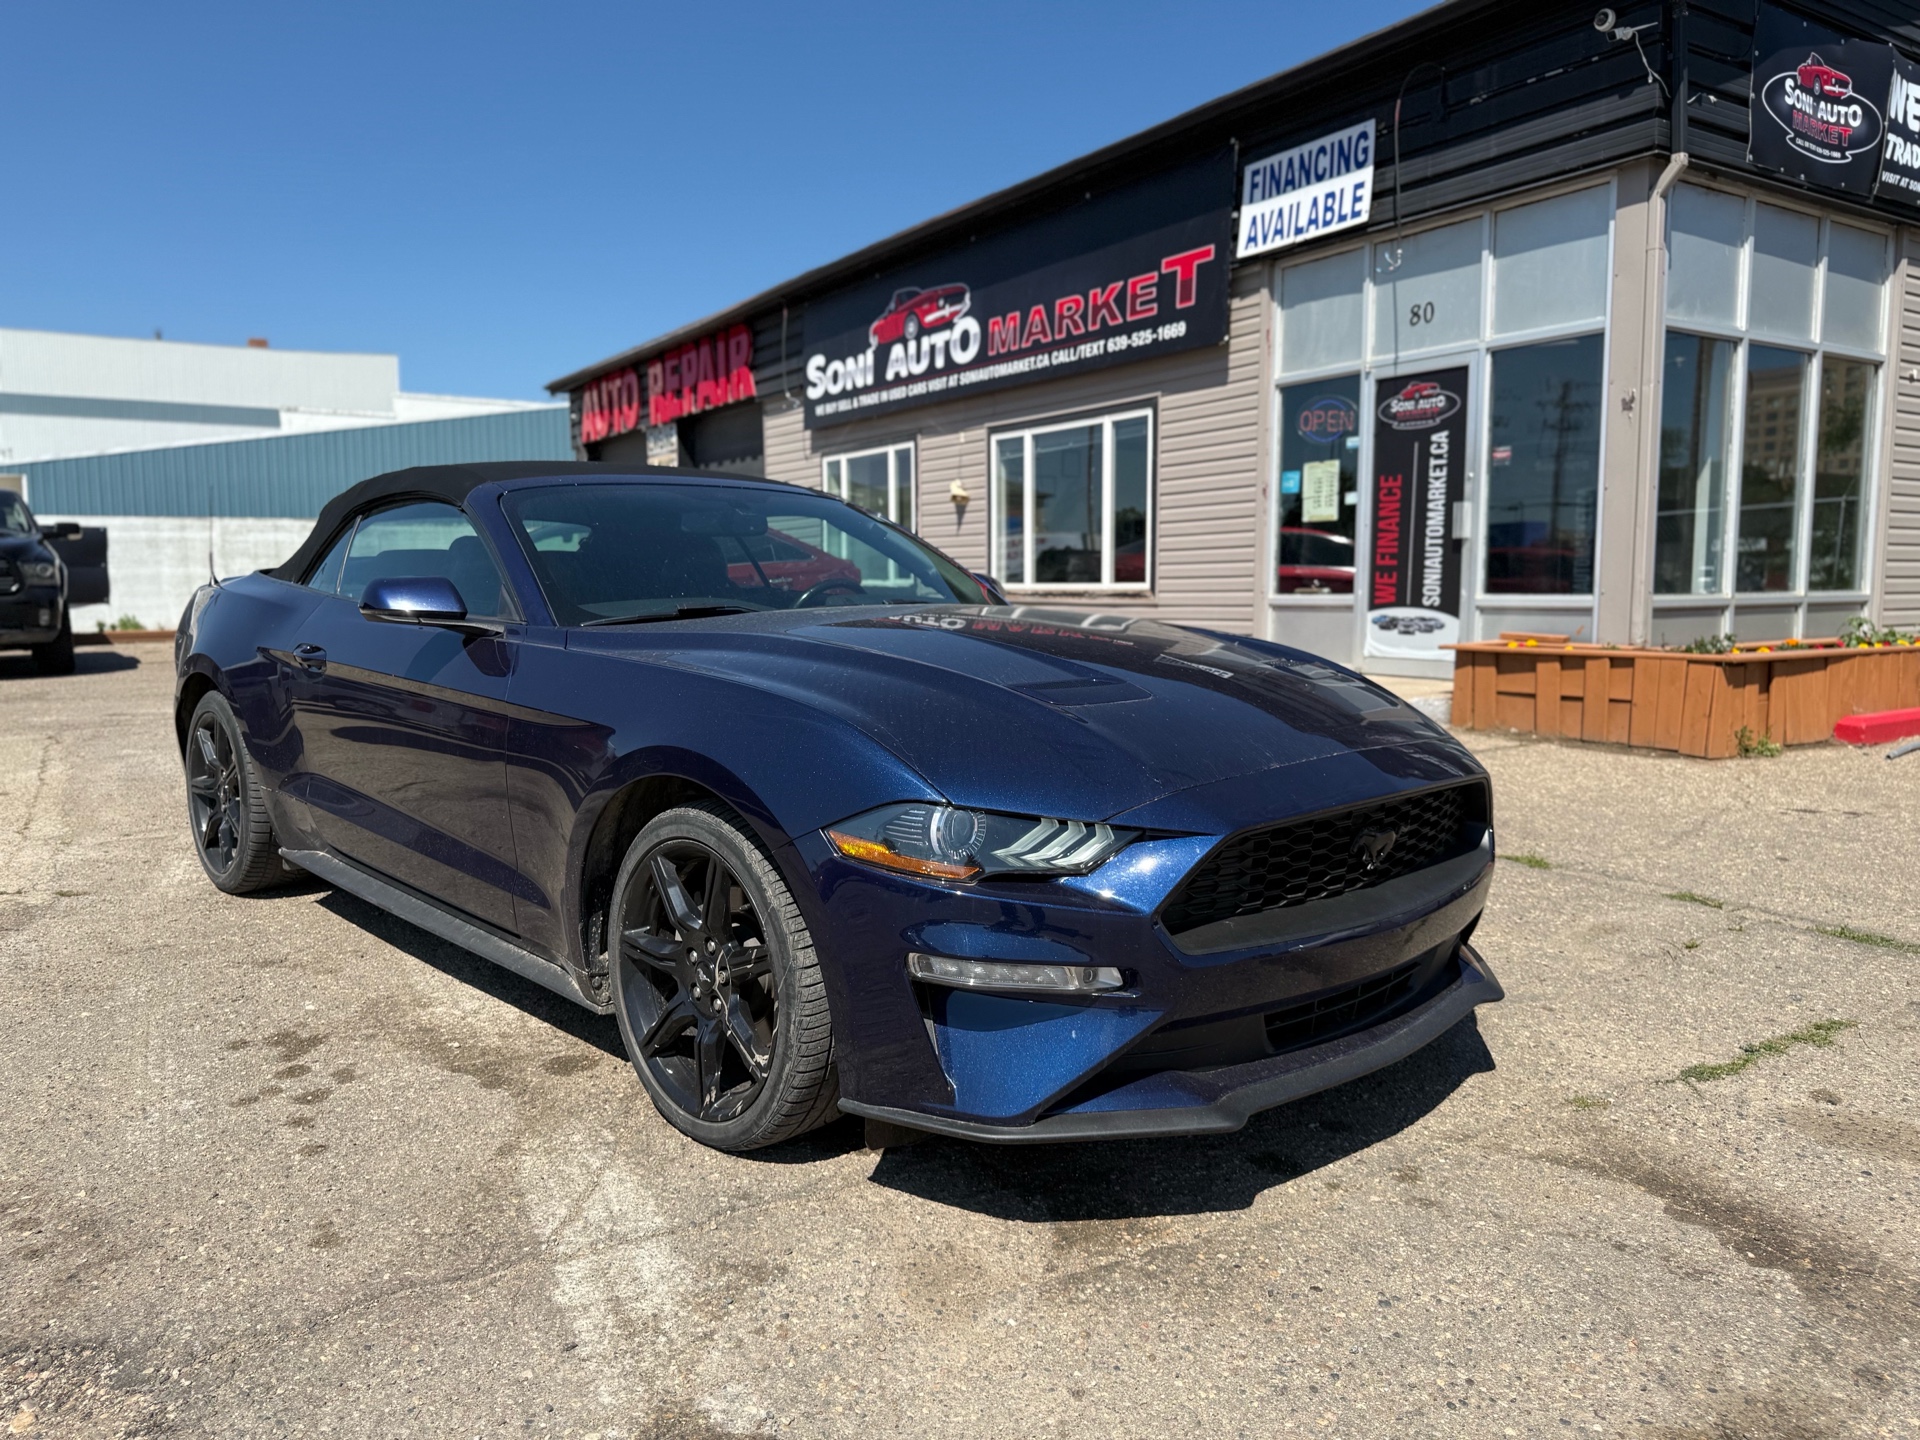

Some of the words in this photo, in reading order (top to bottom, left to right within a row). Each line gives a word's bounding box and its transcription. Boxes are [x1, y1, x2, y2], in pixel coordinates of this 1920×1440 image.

[1784, 77, 1813, 115] SONI
[1817, 100, 1862, 127] AUTO
[1792, 110, 1853, 147] MARKET
[1249, 130, 1370, 204] FINANCING
[1882, 170, 1900, 184] VISIT
[1901, 175, 1909, 187] AT
[1245, 180, 1366, 250] AVAILABLE
[806, 350, 874, 400] SONI
[885, 316, 982, 381] AUTO
[987, 244, 1215, 356] MARKET
[1408, 301, 1435, 326] 80
[581, 367, 641, 444] AUTO
[648, 324, 757, 426] REPAIR
[889, 387, 907, 401] USED
[908, 382, 927, 397] CARS
[928, 377, 947, 393] VISIT
[948, 375, 959, 388] AT
[959, 355, 1050, 386] SONIAUTOMARKET.CA
[1051, 340, 1105, 366] CALL/TEXT
[1107, 321, 1187, 353] 639-525-1669
[1300, 410, 1355, 432] OPEN
[1418, 395, 1446, 409] AUTO
[1375, 474, 1402, 560] FINANCE
[1422, 430, 1449, 607] SONIAUTOMARKET.CA
[1374, 562, 1398, 606] WE
